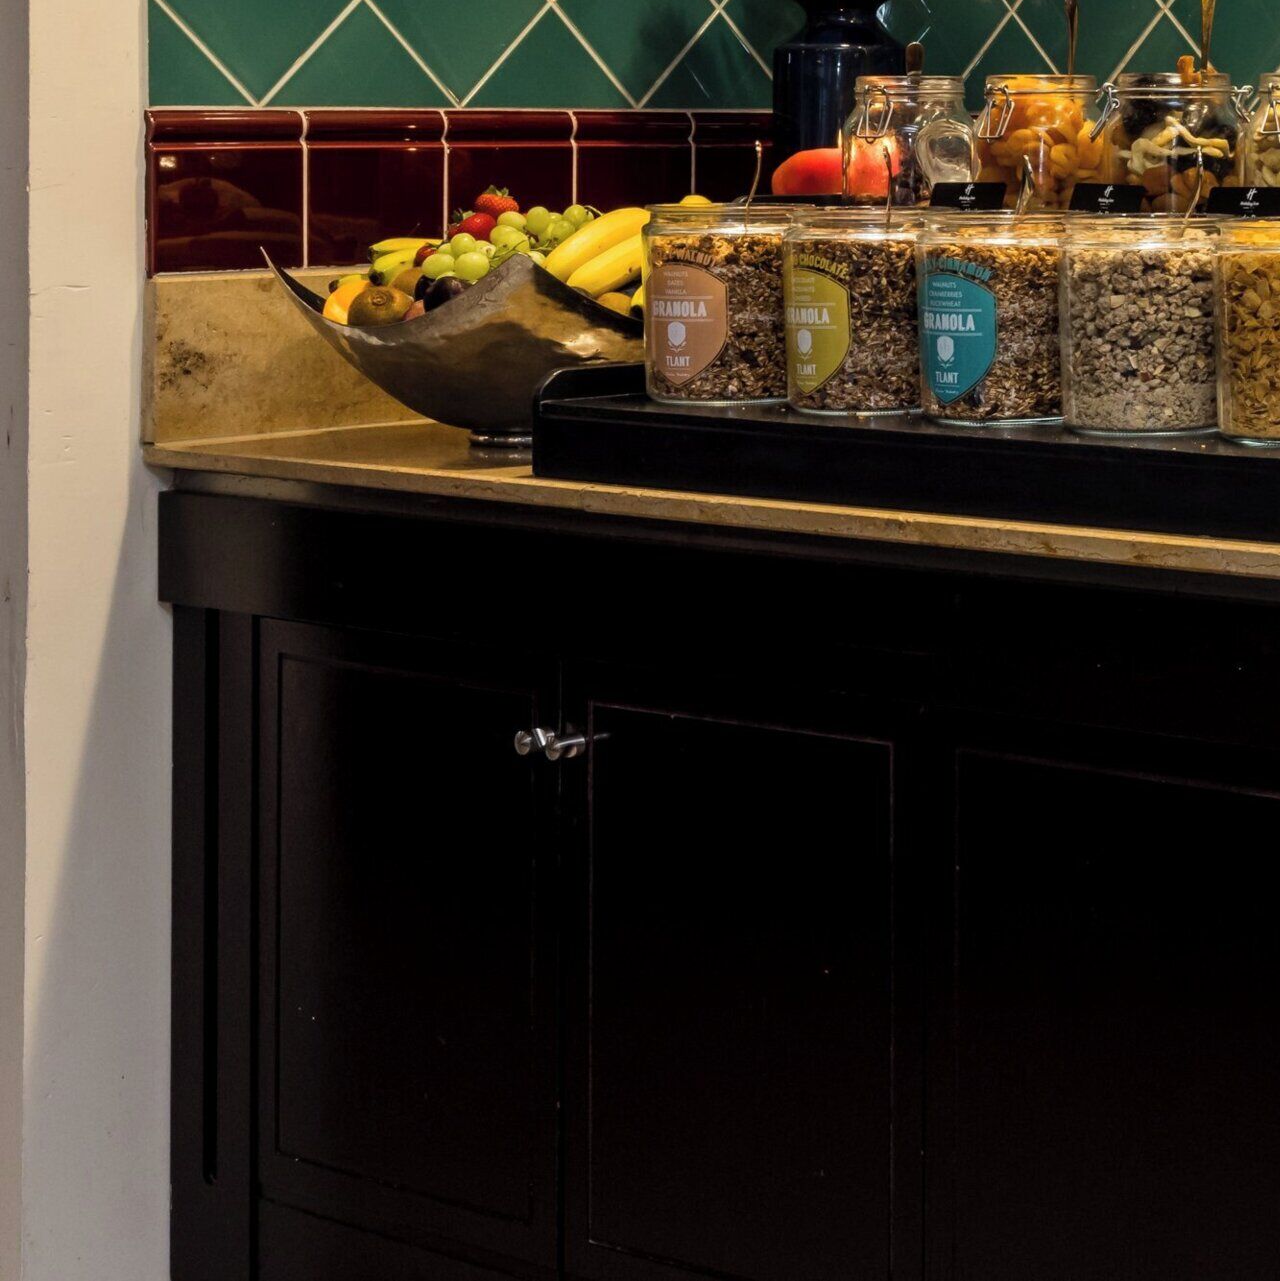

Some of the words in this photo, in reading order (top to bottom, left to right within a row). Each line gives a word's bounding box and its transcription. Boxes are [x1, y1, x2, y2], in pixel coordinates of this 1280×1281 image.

[653, 300, 708, 317] GRANOLA
[924, 312, 975, 331] GRANOLA
[665, 356, 690, 367] TLANT
[796, 364, 816, 375] TLANT
[935, 371, 959, 384] TLANT
